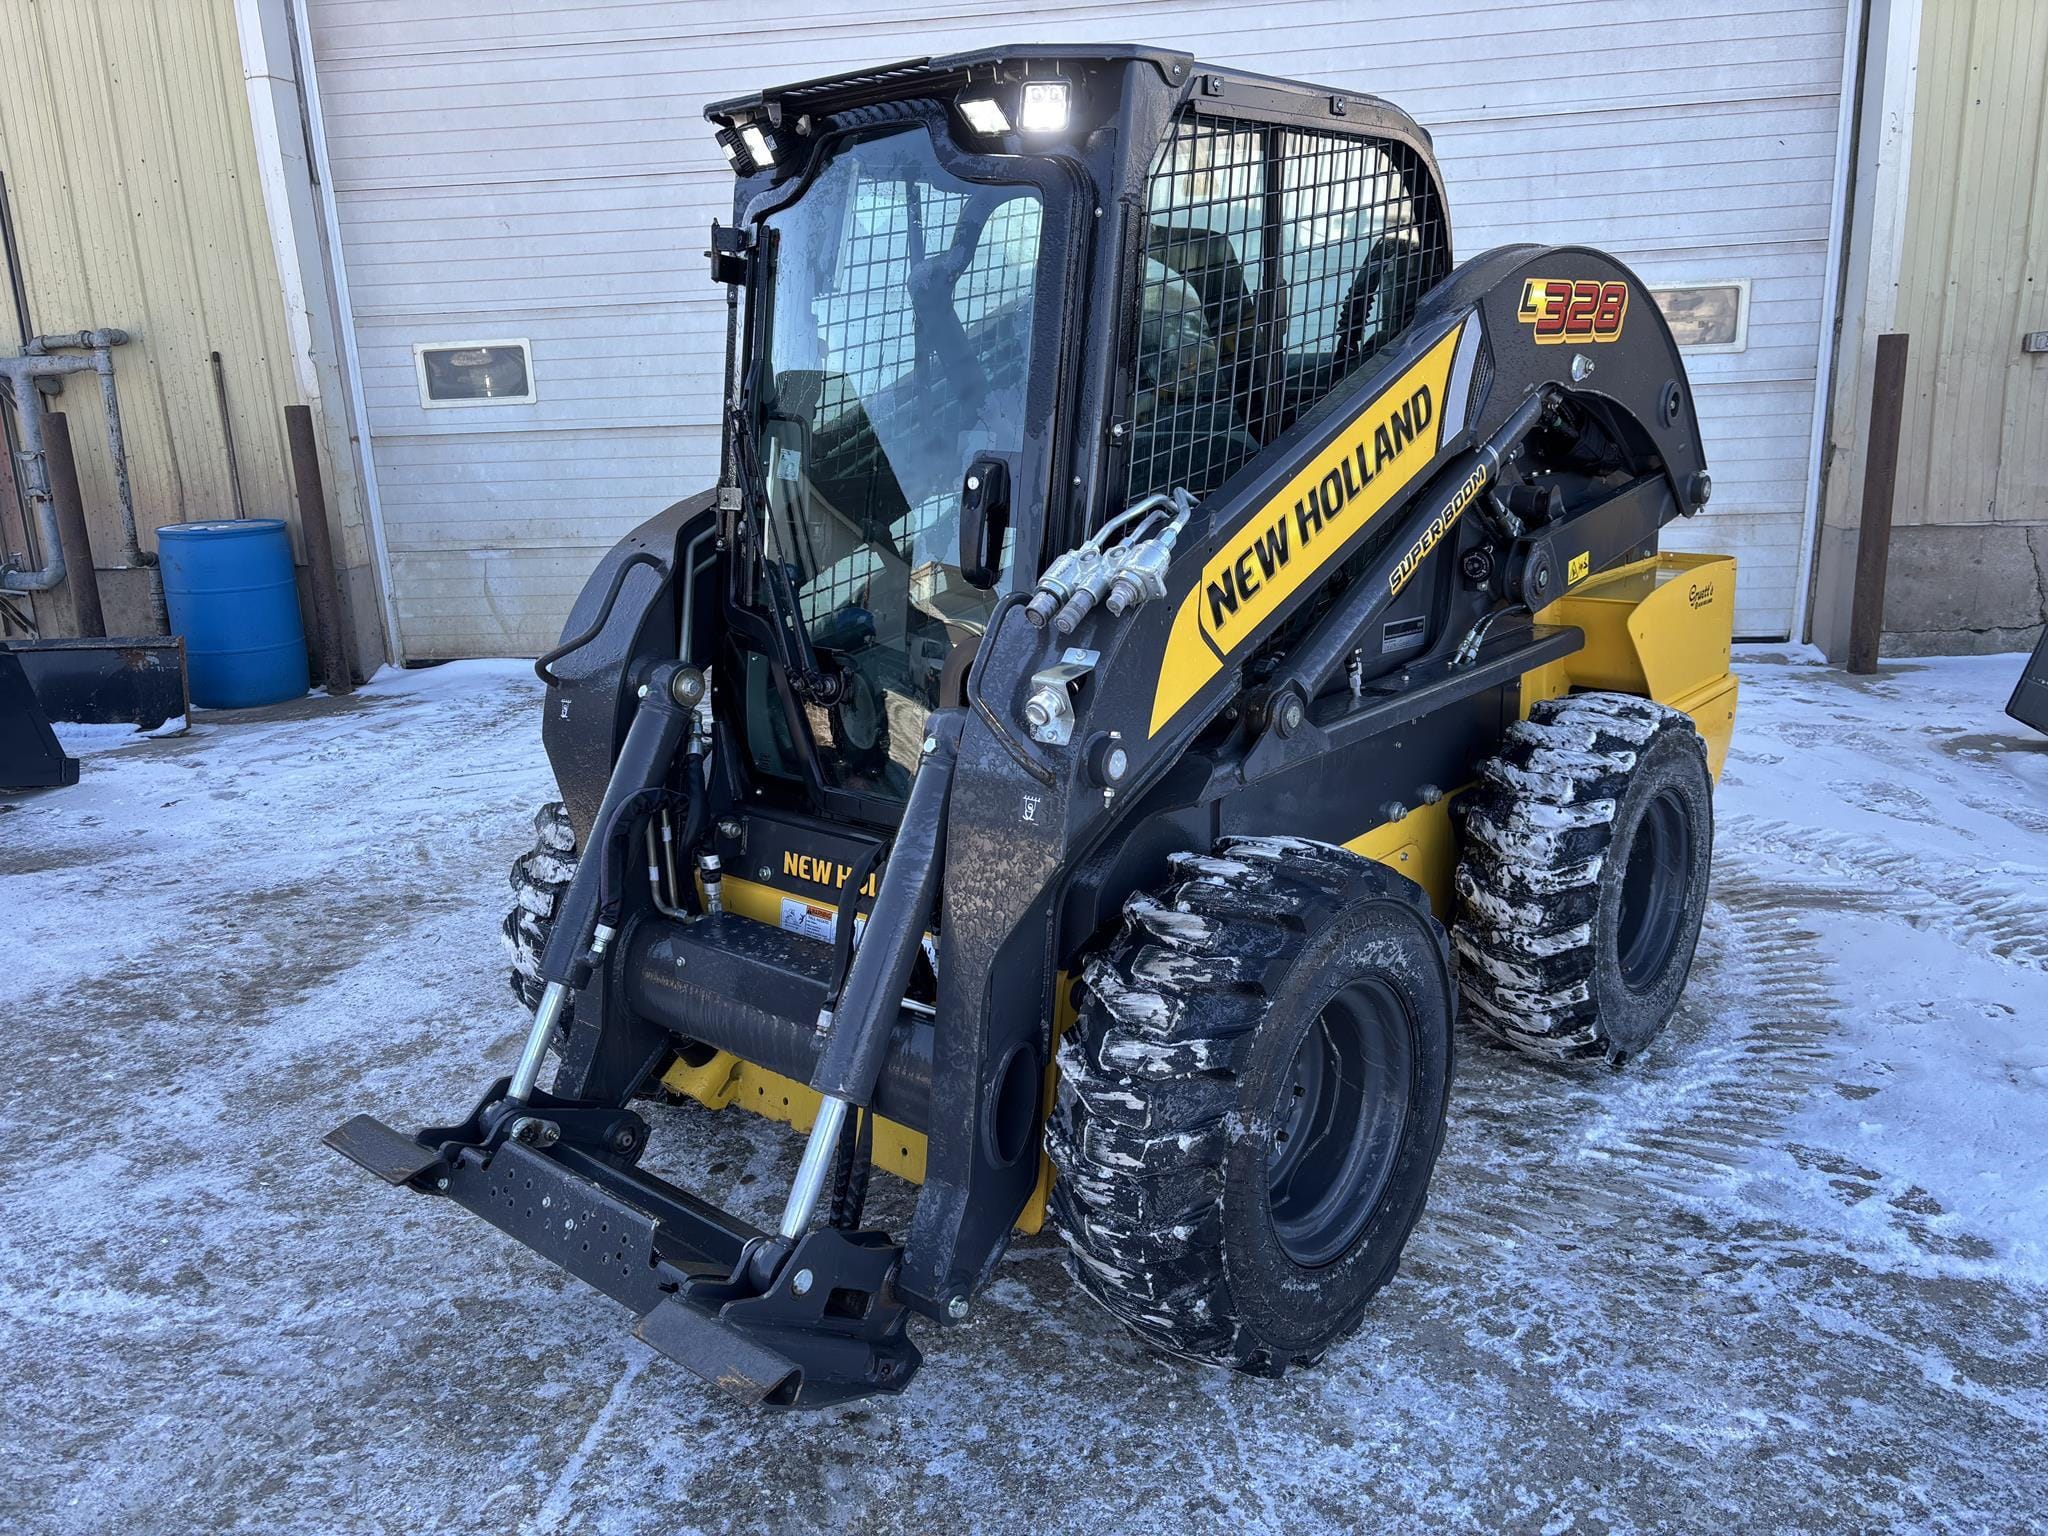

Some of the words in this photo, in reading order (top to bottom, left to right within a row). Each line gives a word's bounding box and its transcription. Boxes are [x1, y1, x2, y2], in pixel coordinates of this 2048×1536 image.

[1518, 279, 1628, 342] L328
[1205, 513, 1290, 631] NEW
[1294, 384, 1433, 548] HOLLAND
[1389, 518, 1443, 595] SUPER
[1441, 464, 1486, 529] BOOM
[783, 850, 832, 885] NEW
